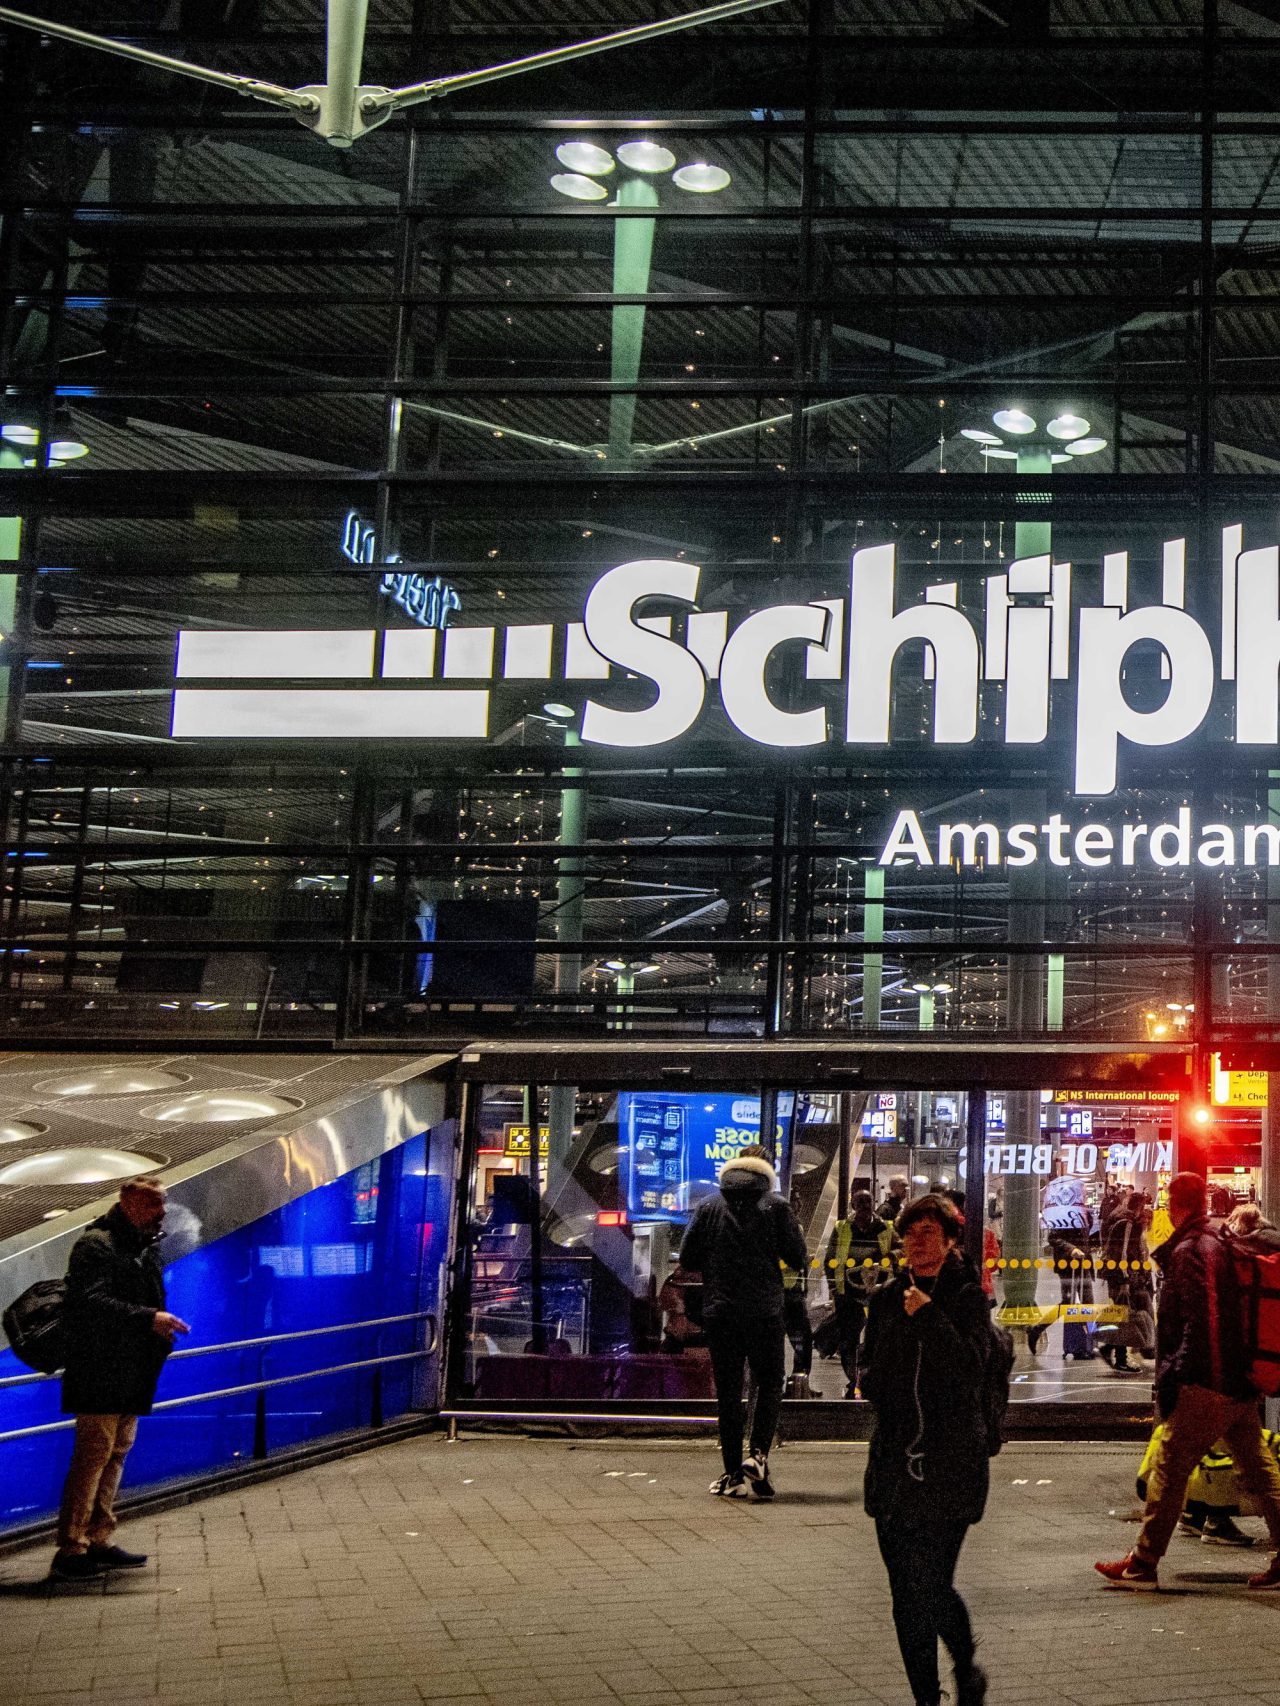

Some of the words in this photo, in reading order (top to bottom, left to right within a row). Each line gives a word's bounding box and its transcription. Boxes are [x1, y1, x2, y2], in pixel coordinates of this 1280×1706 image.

[1070, 1091, 1083, 1100] NS
[1086, 1091, 1146, 1100] International
[1149, 1091, 1179, 1102] lounge
